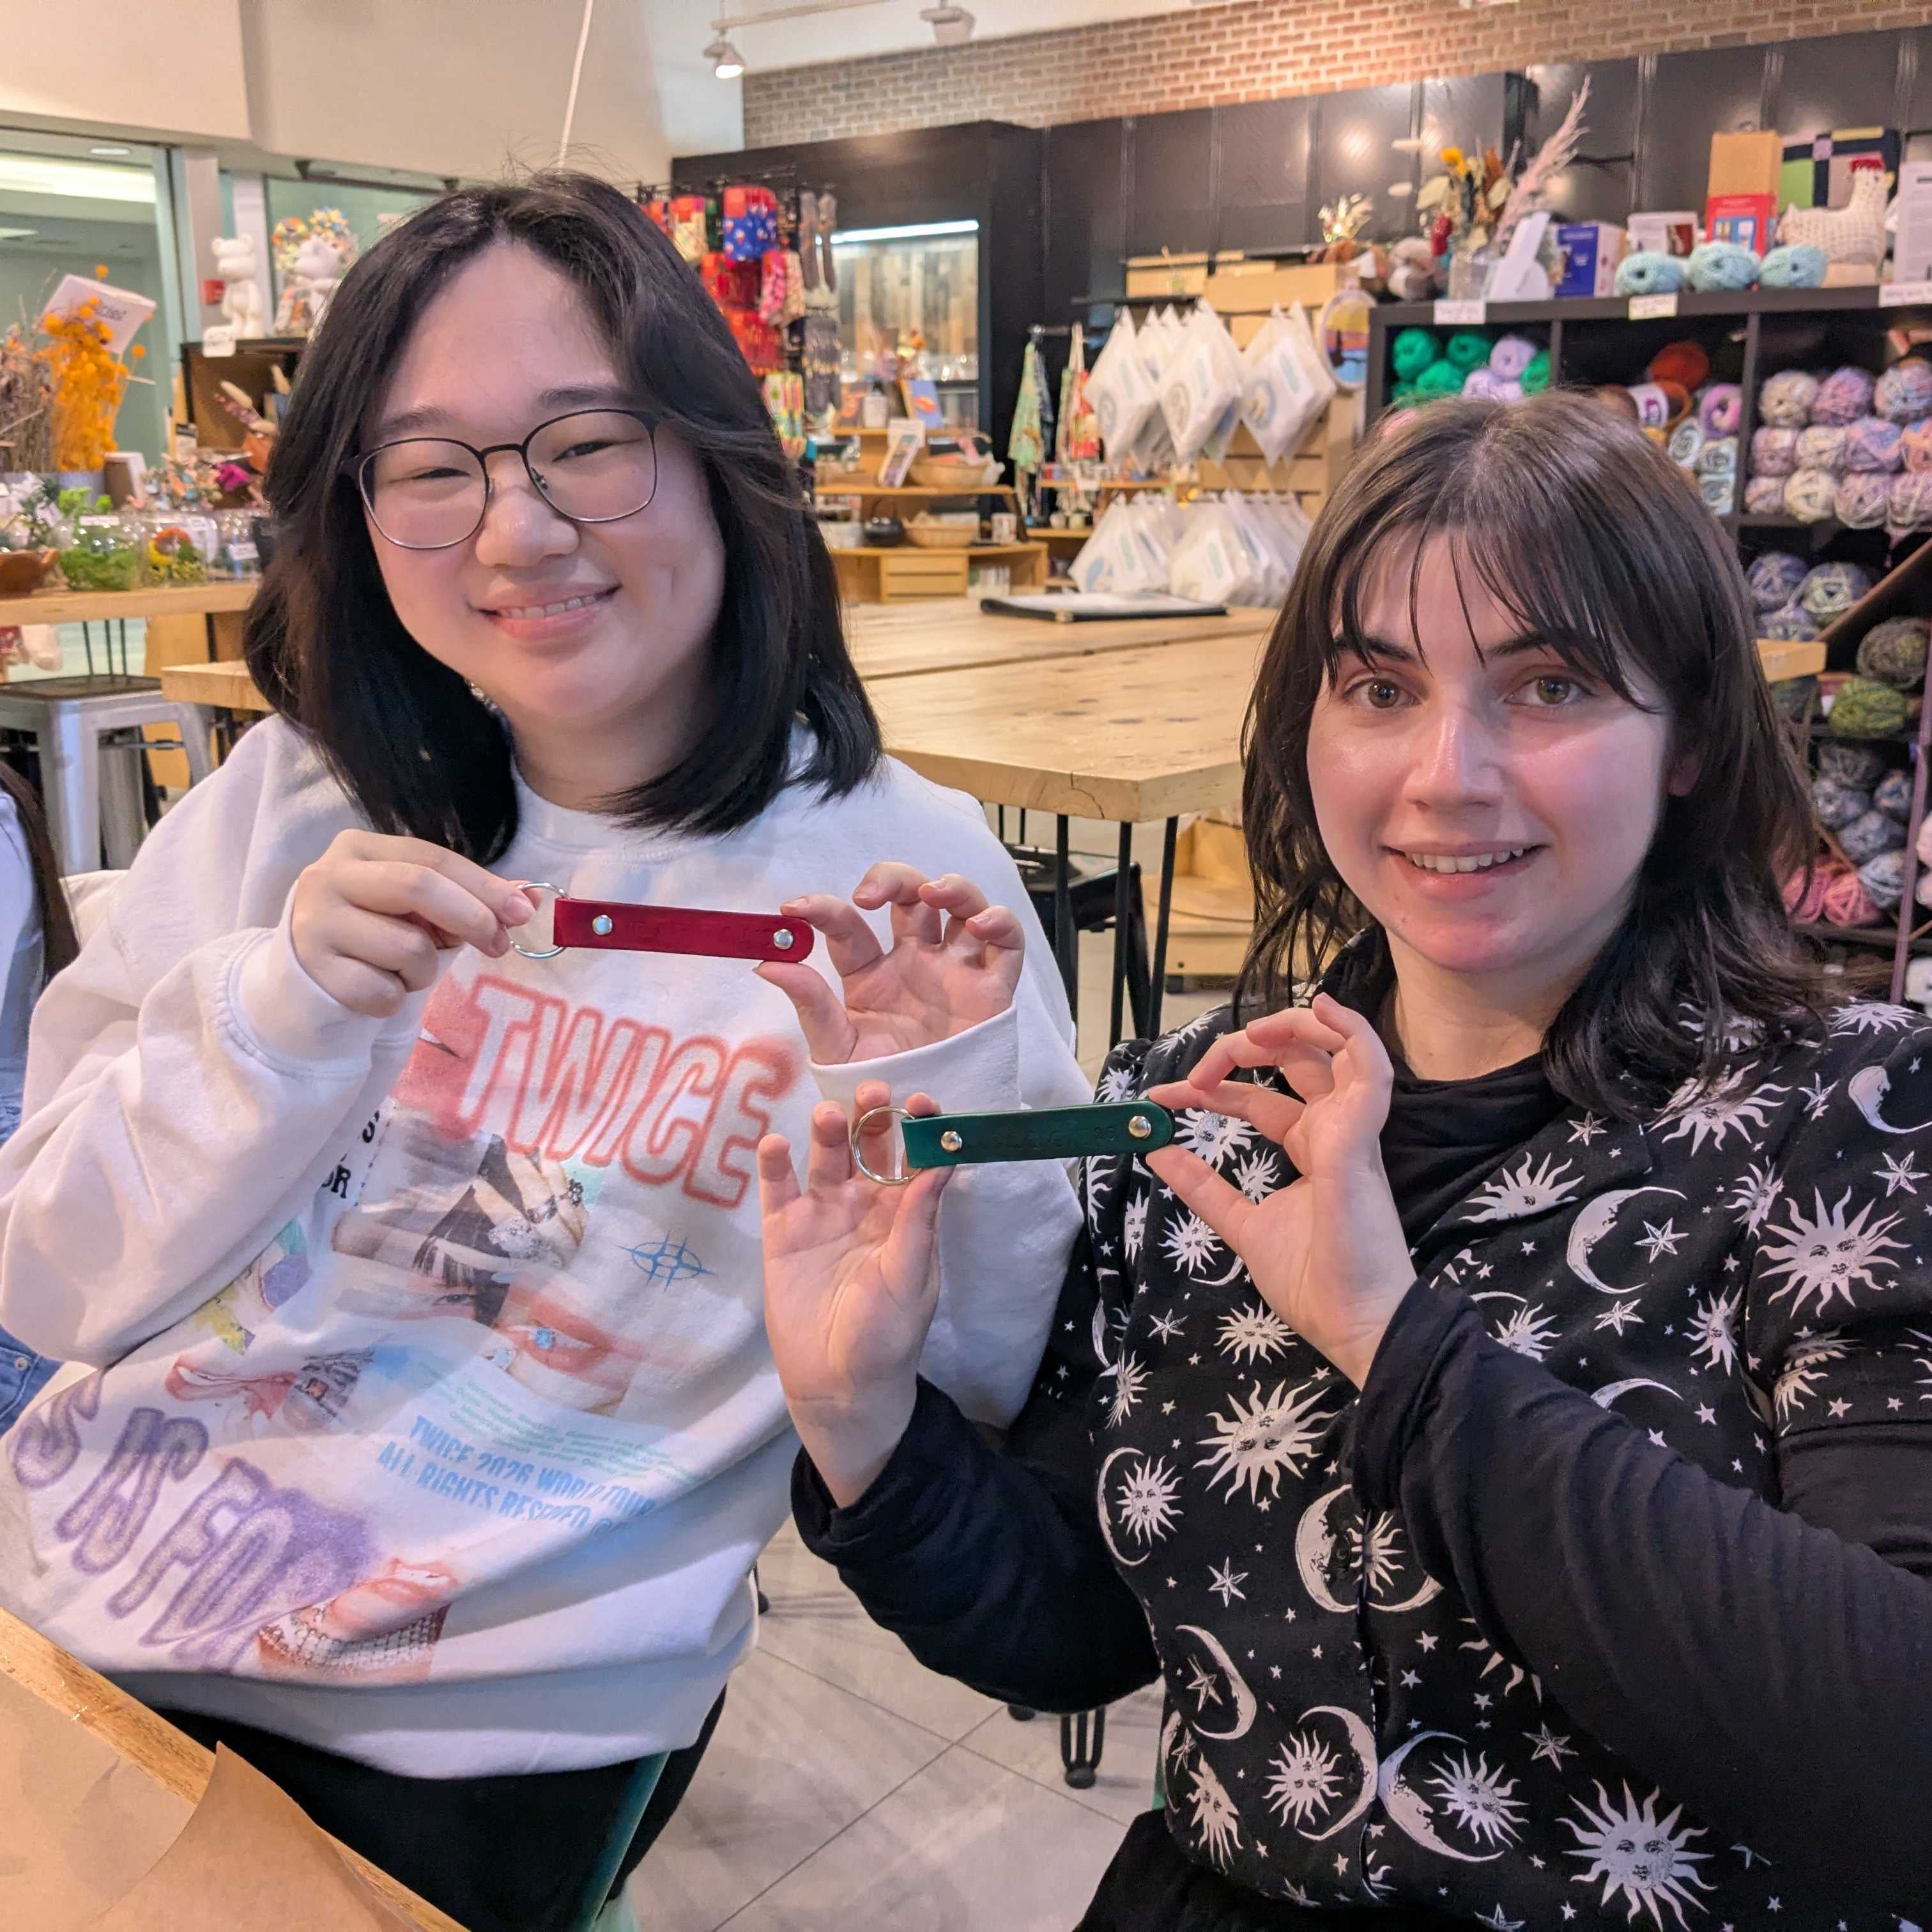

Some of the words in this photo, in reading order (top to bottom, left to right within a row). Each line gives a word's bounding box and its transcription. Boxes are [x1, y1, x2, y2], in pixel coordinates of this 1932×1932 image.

[456, 974, 797, 1209] TWICE
[409, 1414, 475, 1463] TWICE
[416, 1461, 499, 1510] RIGHTS
